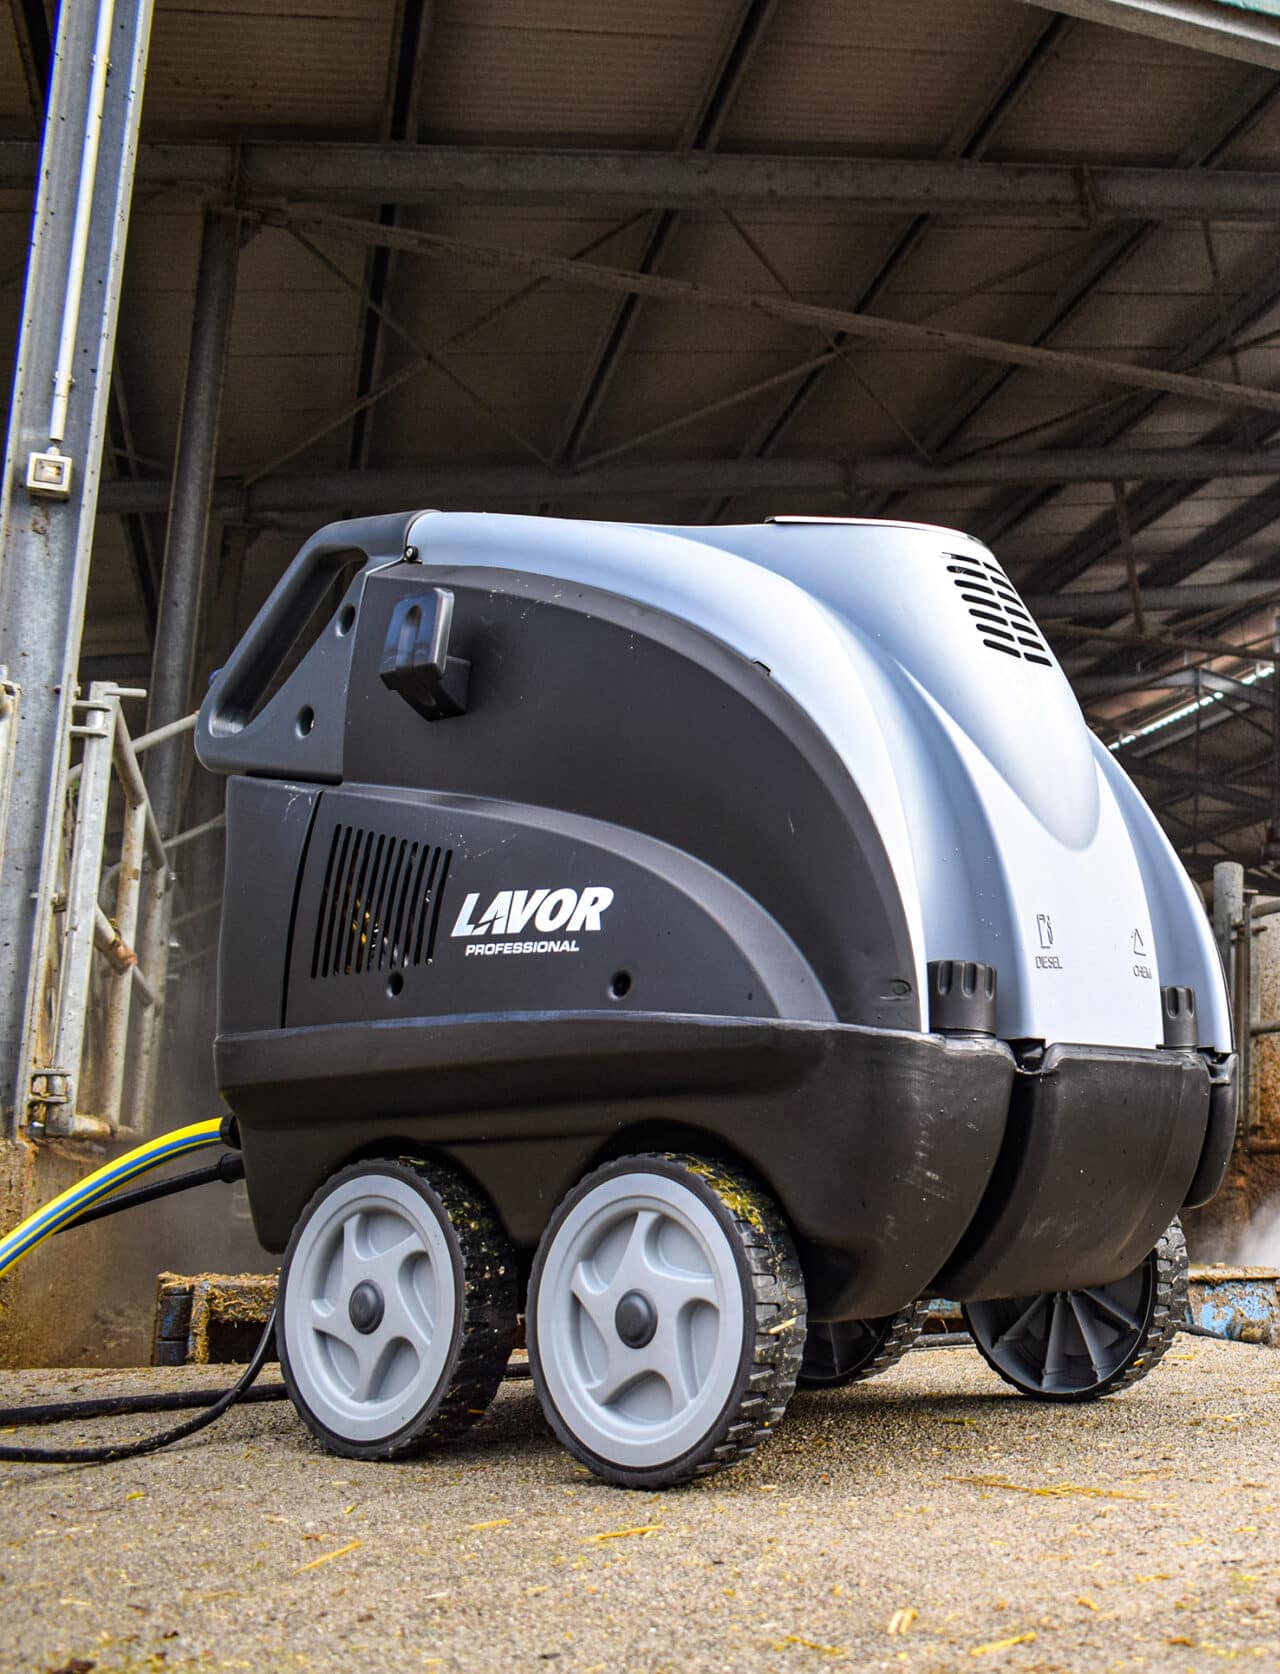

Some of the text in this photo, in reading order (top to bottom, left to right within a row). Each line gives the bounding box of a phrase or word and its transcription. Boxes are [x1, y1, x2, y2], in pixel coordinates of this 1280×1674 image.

[451, 886, 615, 937] LAVOR
[465, 940, 580, 956] PROFESSIONAL
[1035, 956, 1063, 969] DIESEL
